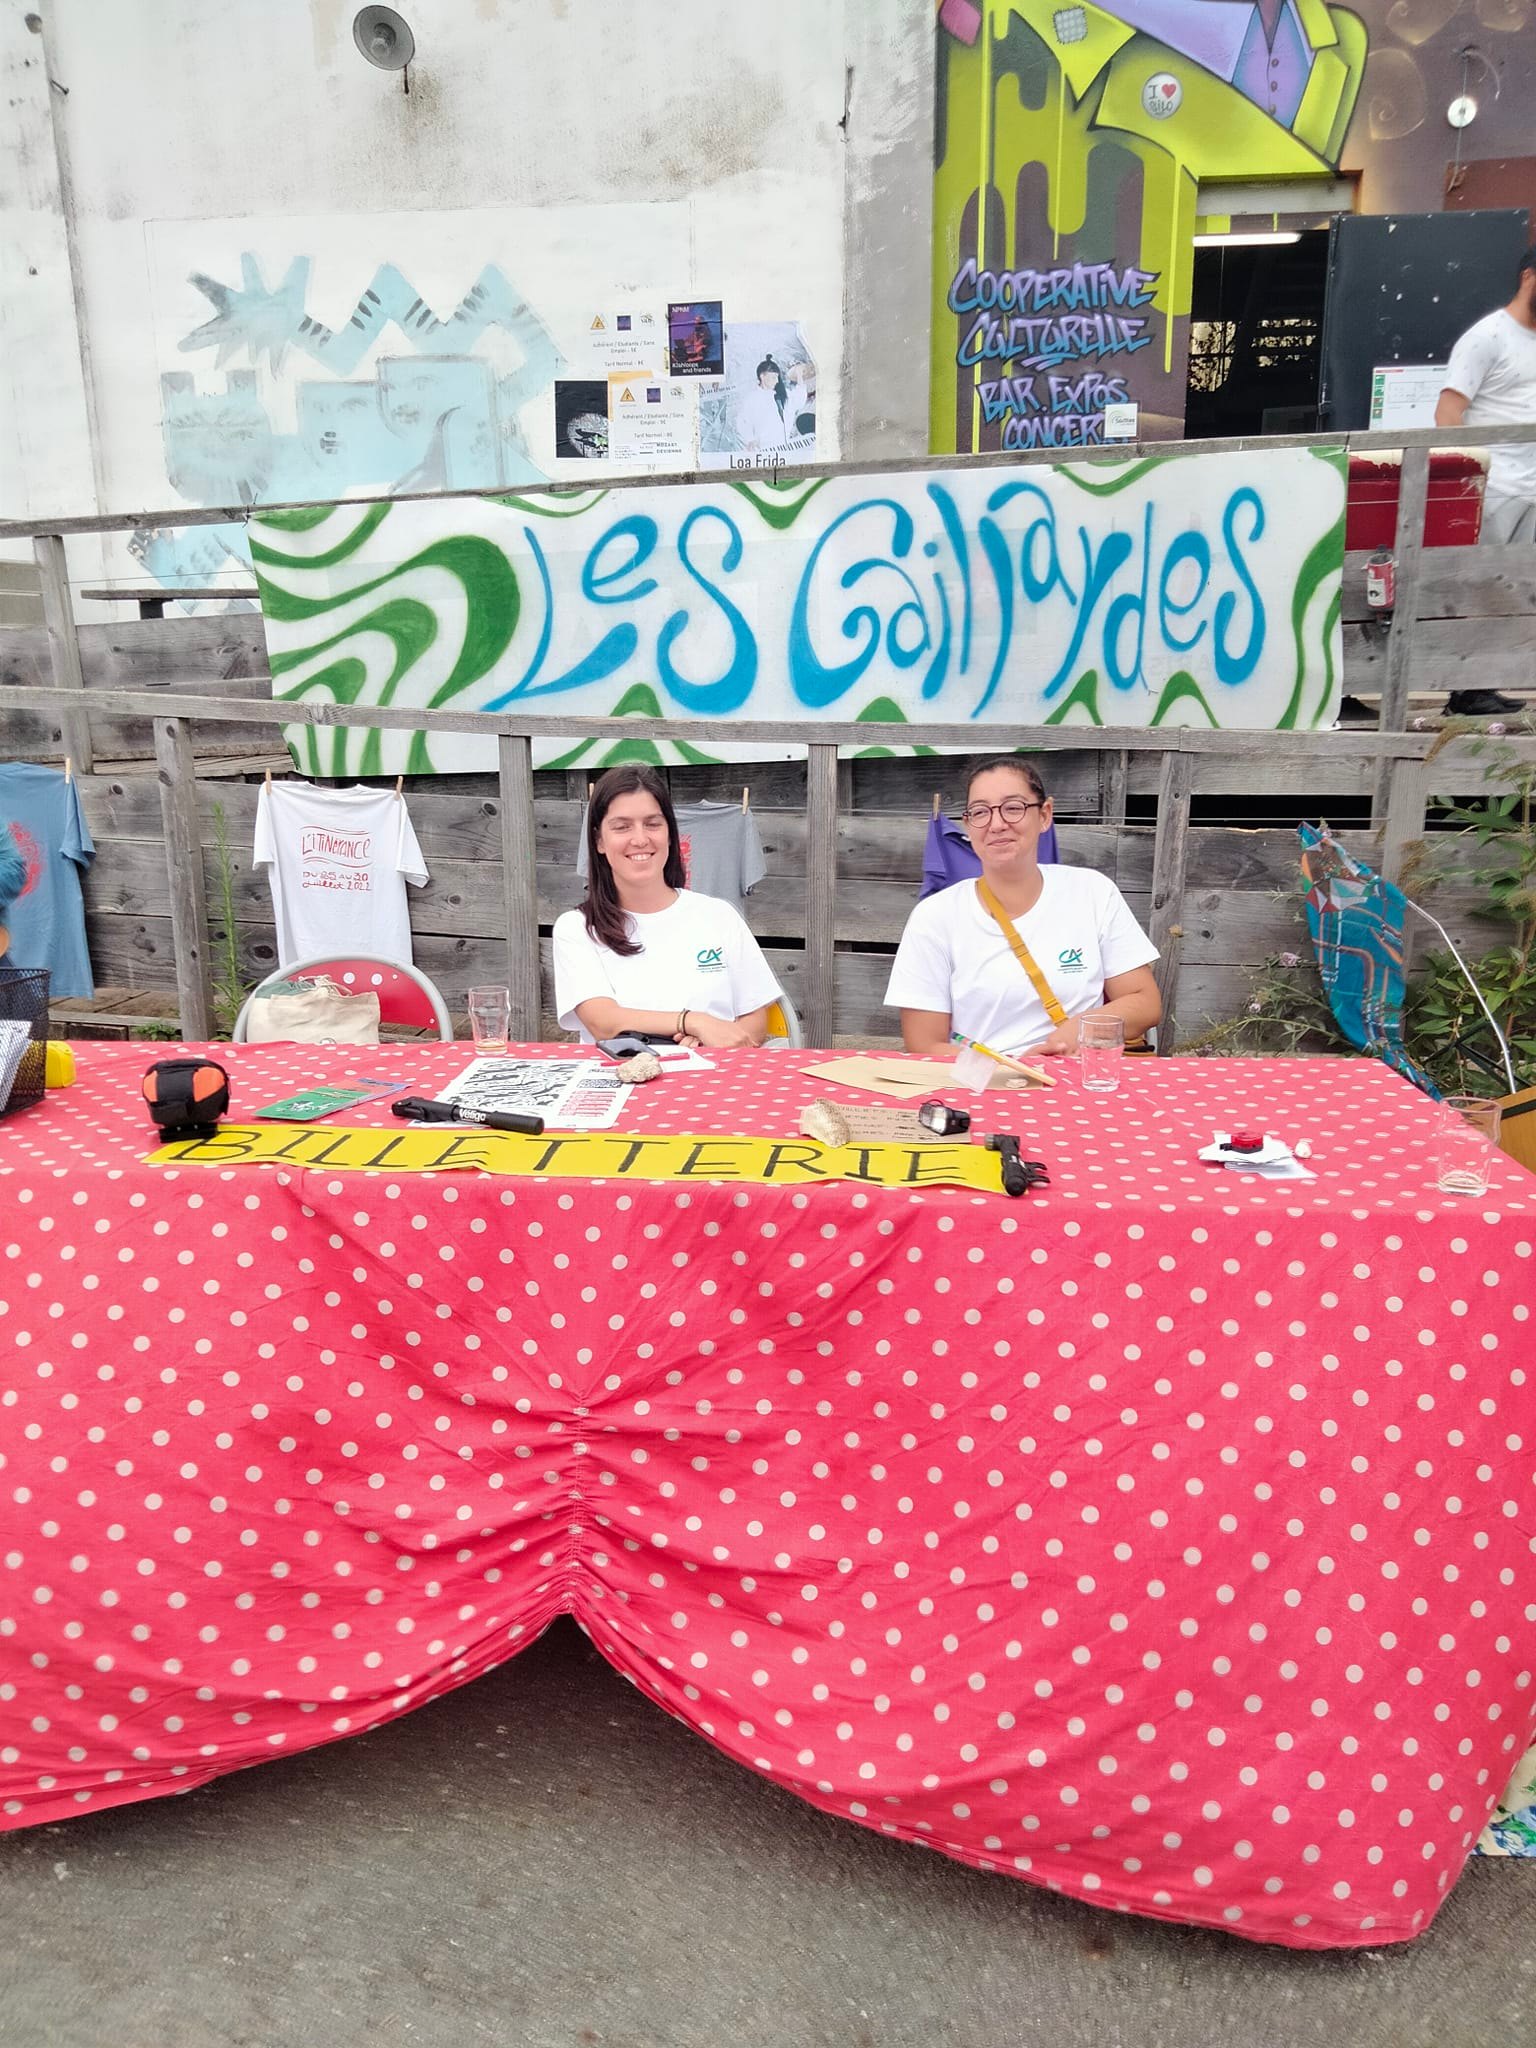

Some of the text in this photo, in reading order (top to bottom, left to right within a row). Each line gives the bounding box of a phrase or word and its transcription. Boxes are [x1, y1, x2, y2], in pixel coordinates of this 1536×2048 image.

[1148, 85, 1158, 99] I
[1003, 412, 1129, 450] CONCER
[730, 453, 786, 469] Loa Frida
[353, 872, 369, 881] 30
[167, 1128, 967, 1183] BILLETTERIE
